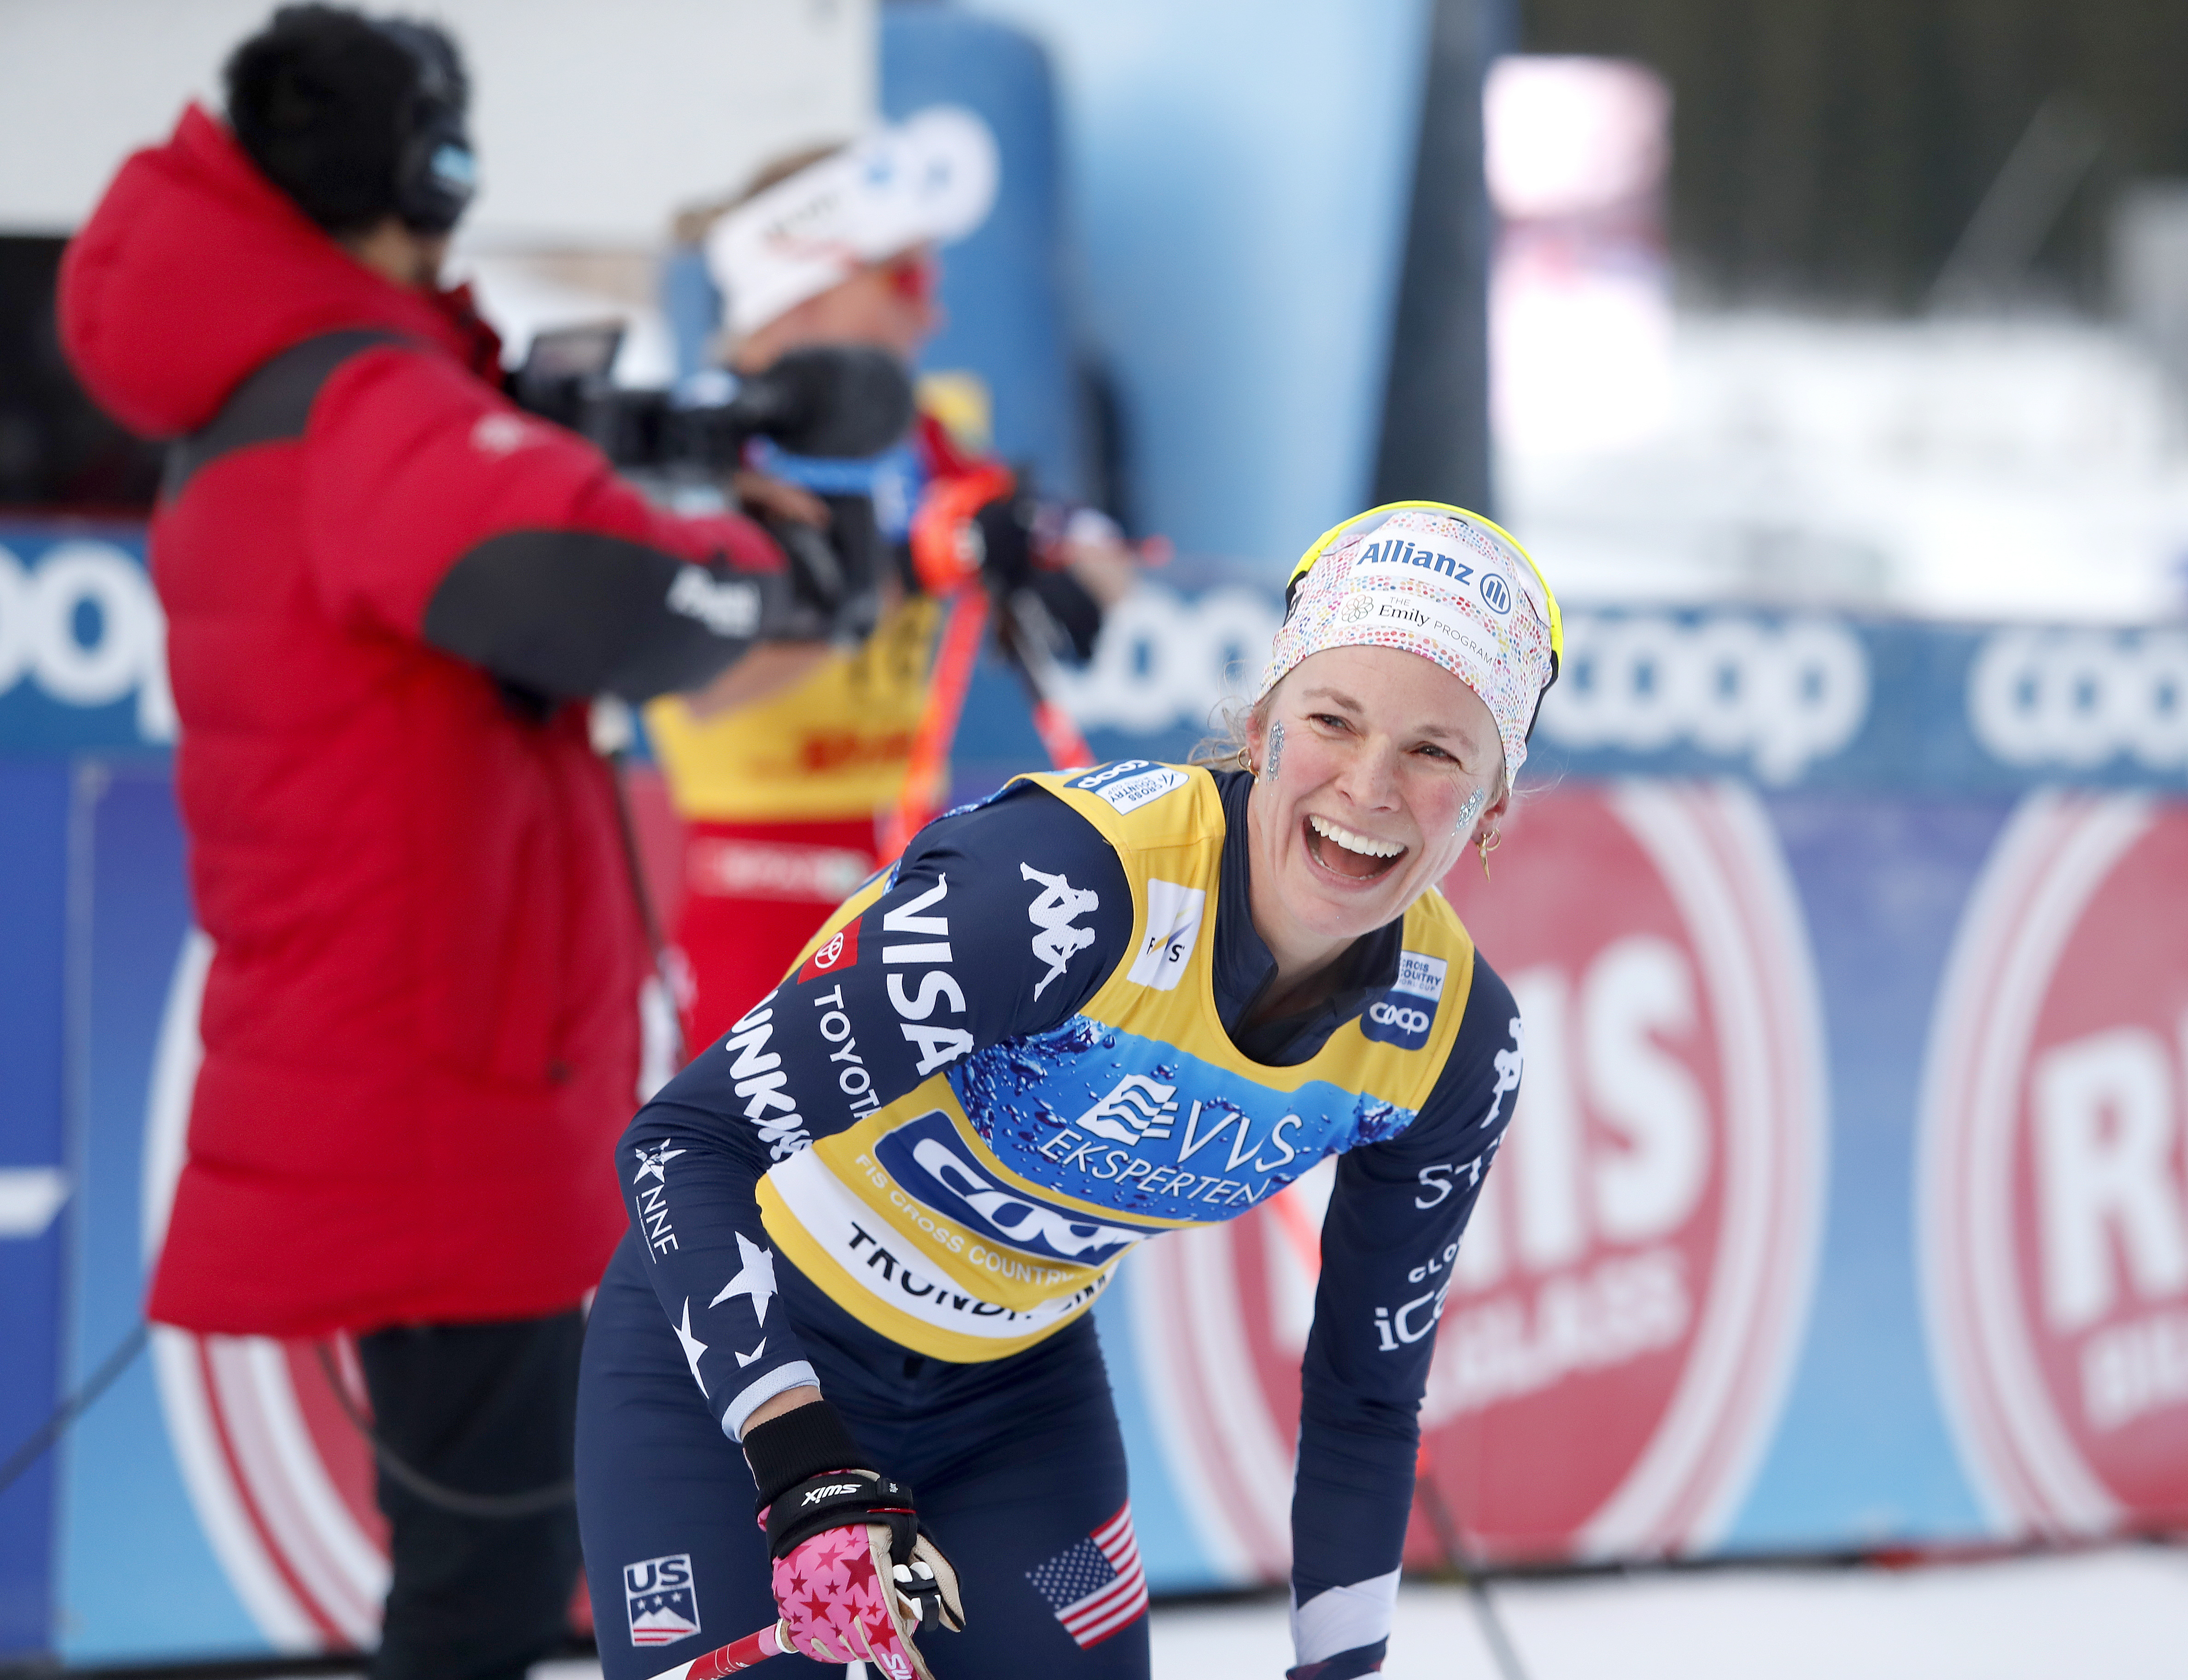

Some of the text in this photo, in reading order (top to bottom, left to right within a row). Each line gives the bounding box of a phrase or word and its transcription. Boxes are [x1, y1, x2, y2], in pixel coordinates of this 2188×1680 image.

[1356, 539, 1474, 586] Allianz
[1390, 596, 1411, 606] THE
[1379, 604, 1493, 667] Emily PROGRAM
[1077, 759, 1149, 788] coop
[1147, 936, 1182, 962] FS
[881, 872, 974, 1077] VISA
[1177, 1099, 1304, 1173] VVS
[1040, 1128, 1271, 1205] EKSPERTEN
[855, 1154, 889, 1189] FIS
[890, 1191, 965, 1253] CROSS
[801, 1484, 862, 1507] swix
[627, 1560, 689, 1592] US
